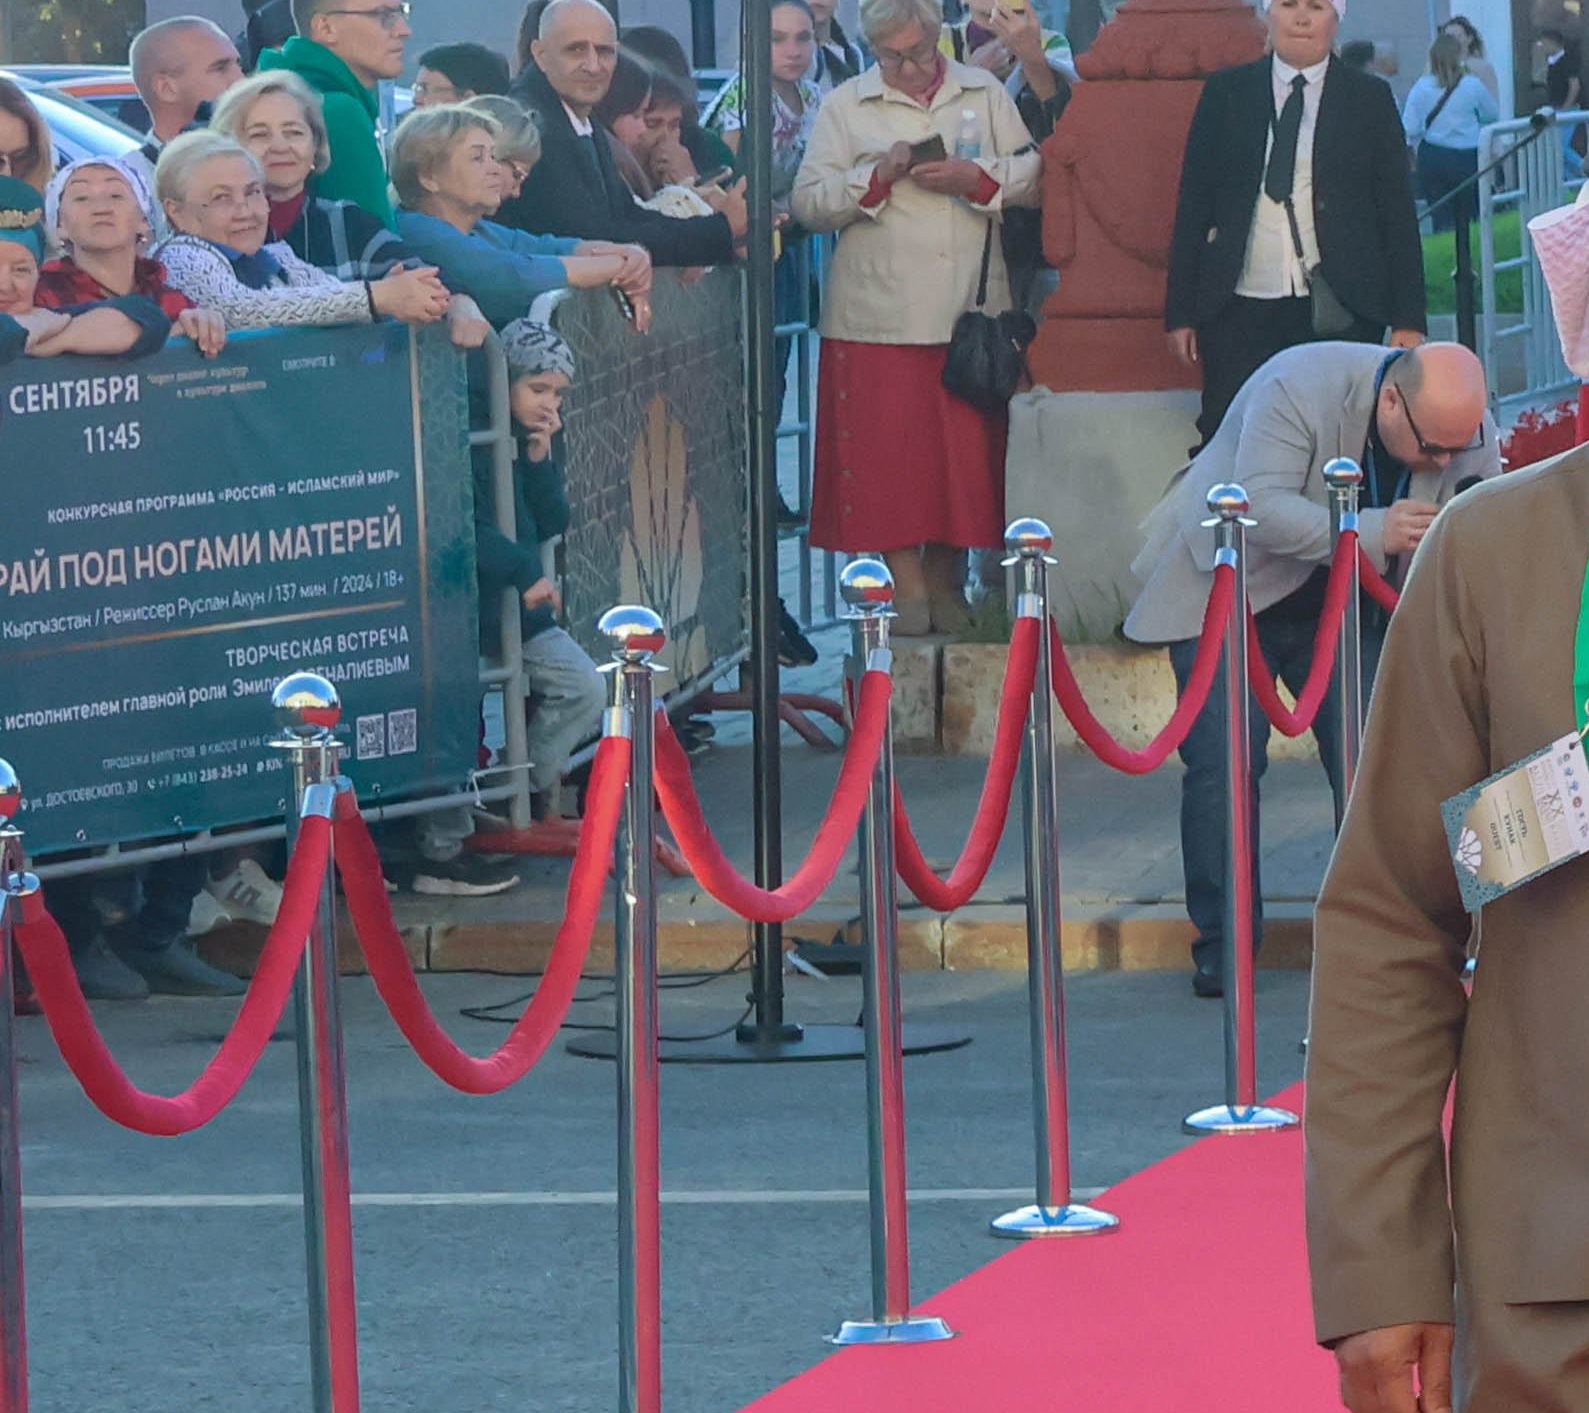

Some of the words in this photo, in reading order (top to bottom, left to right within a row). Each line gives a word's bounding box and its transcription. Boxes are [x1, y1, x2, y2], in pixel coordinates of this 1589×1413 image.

[9, 374, 140, 414] СЕНТЯБРЯ
[83, 421, 141, 454] 11:45
[48, 499, 134, 524] КОНКУРСНАЯ
[136, 490, 215, 513] ПРОГРАММА
[287, 469, 366, 495] ИСЛАМСКИЙ
[58, 547, 129, 589] ПОД
[134, 530, 262, 581] НОГАМИ
[268, 504, 402, 563] МАТЕРЕЙ
[3, 611, 92, 641] Кыргызстан
[103, 600, 176, 626] Режиссер
[178, 593, 229, 620] Руслан
[231, 590, 265, 611] Акун
[275, 583, 296, 602] 137
[341, 574, 373, 594] 2024
[383, 569, 405, 587] 18+
[225, 636, 333, 668] ТВОРЧЕСКАЯ
[337, 625, 409, 653] ВСТРЕЧА
[5, 699, 121, 731] исполнителем
[122, 685, 187, 713] главной
[188, 686, 228, 709] роли
[1503, 814, 1516, 844] КУНАК
[1515, 809, 1529, 838] ГОСТЬ
